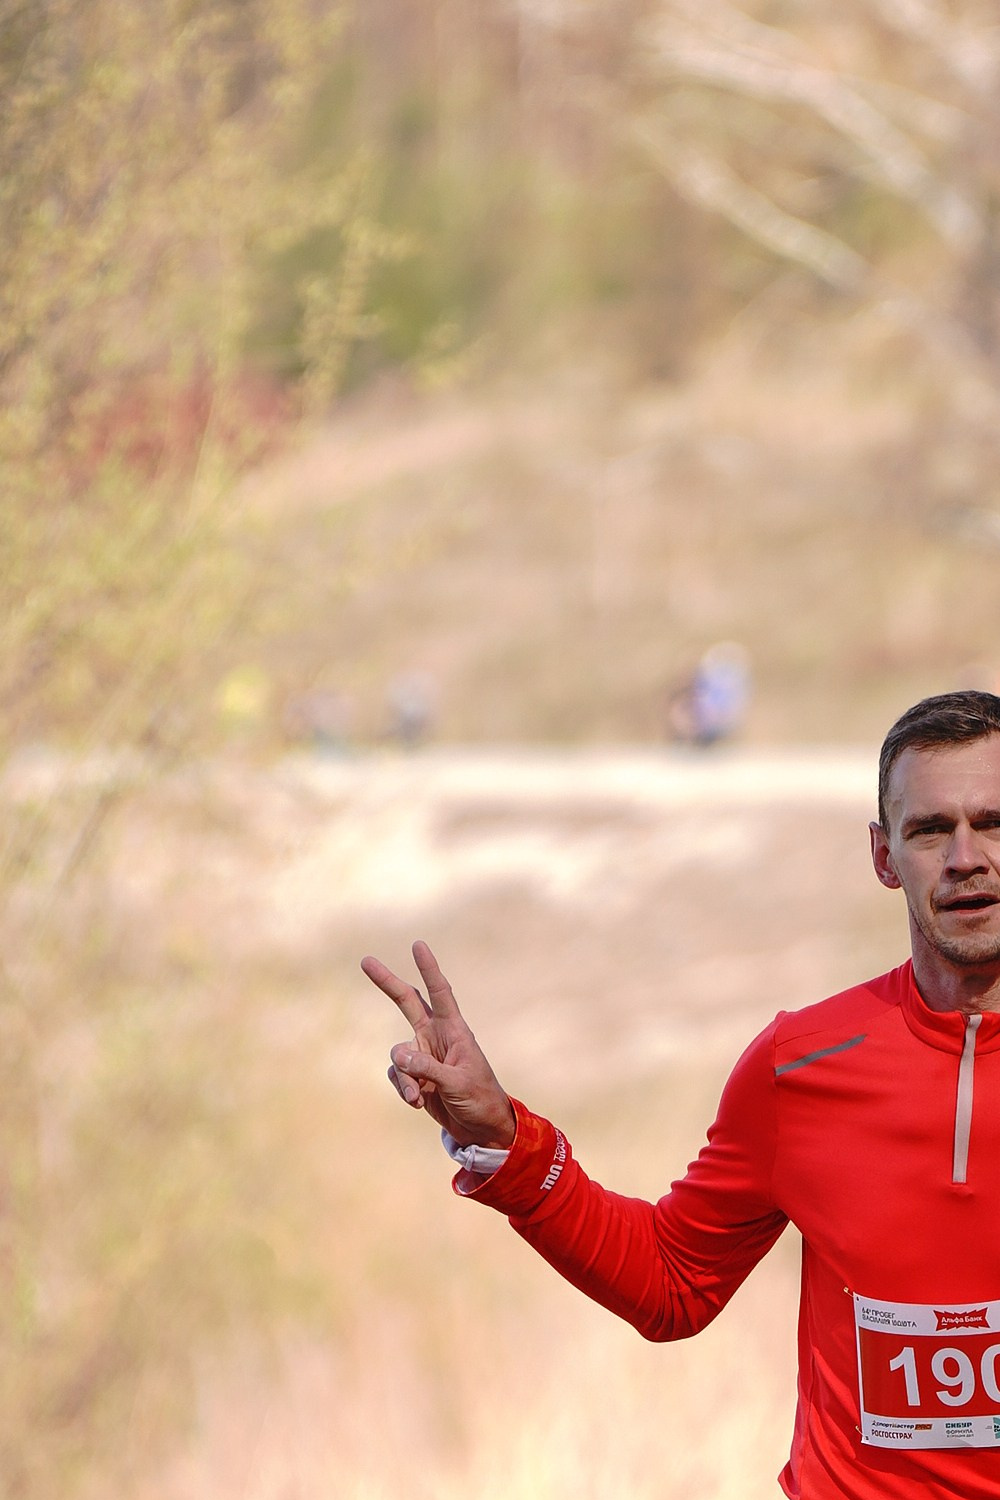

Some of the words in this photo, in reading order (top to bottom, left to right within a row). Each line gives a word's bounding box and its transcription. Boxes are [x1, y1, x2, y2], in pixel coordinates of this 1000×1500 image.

[941, 1316, 964, 1324] Альфа
[964, 1315, 983, 1323] Банк
[871, 1429, 913, 1440] РОСГОССТРАХ
